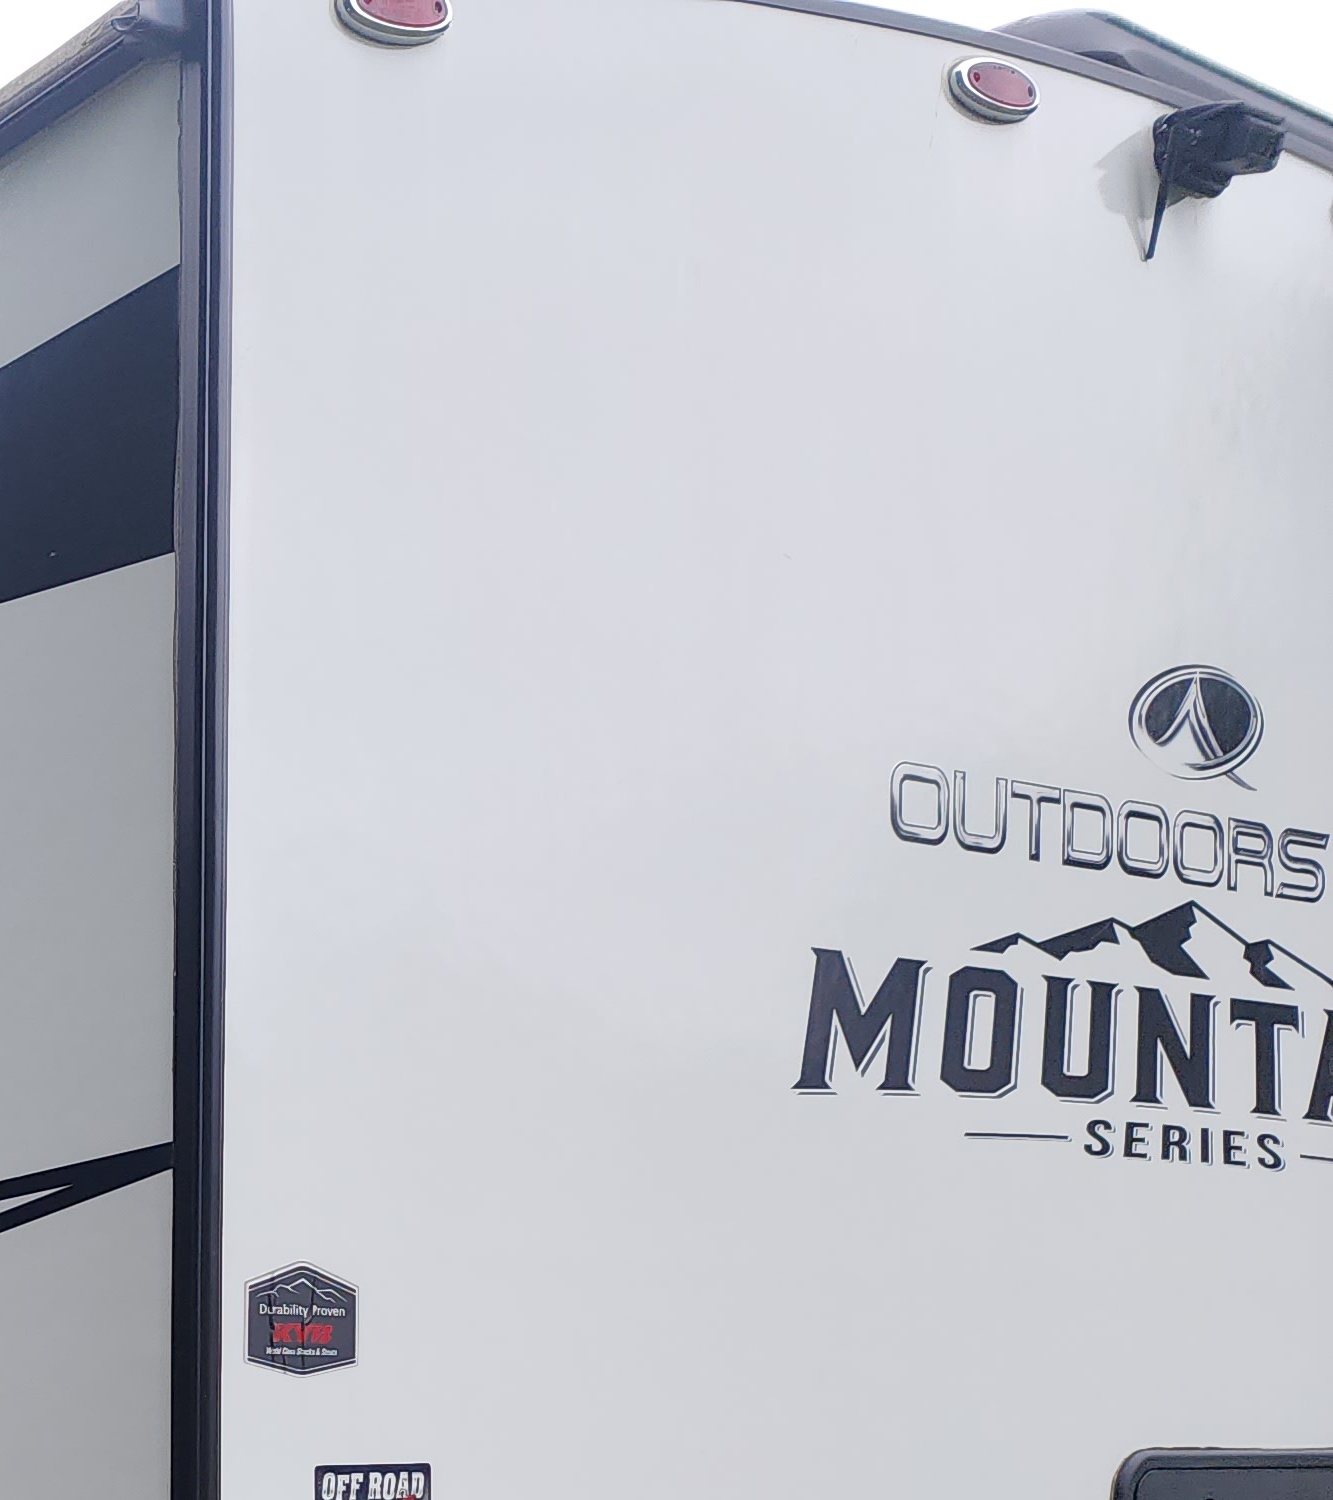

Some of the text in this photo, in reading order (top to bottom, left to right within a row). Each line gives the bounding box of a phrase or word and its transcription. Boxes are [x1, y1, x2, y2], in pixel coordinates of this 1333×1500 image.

[890, 761, 1331, 903] OUTDOORS
[1084, 1119, 1287, 1172] SERIES
[259, 1303, 346, 1318] Durability Proven
[367, 1472, 424, 1500] ROAD
